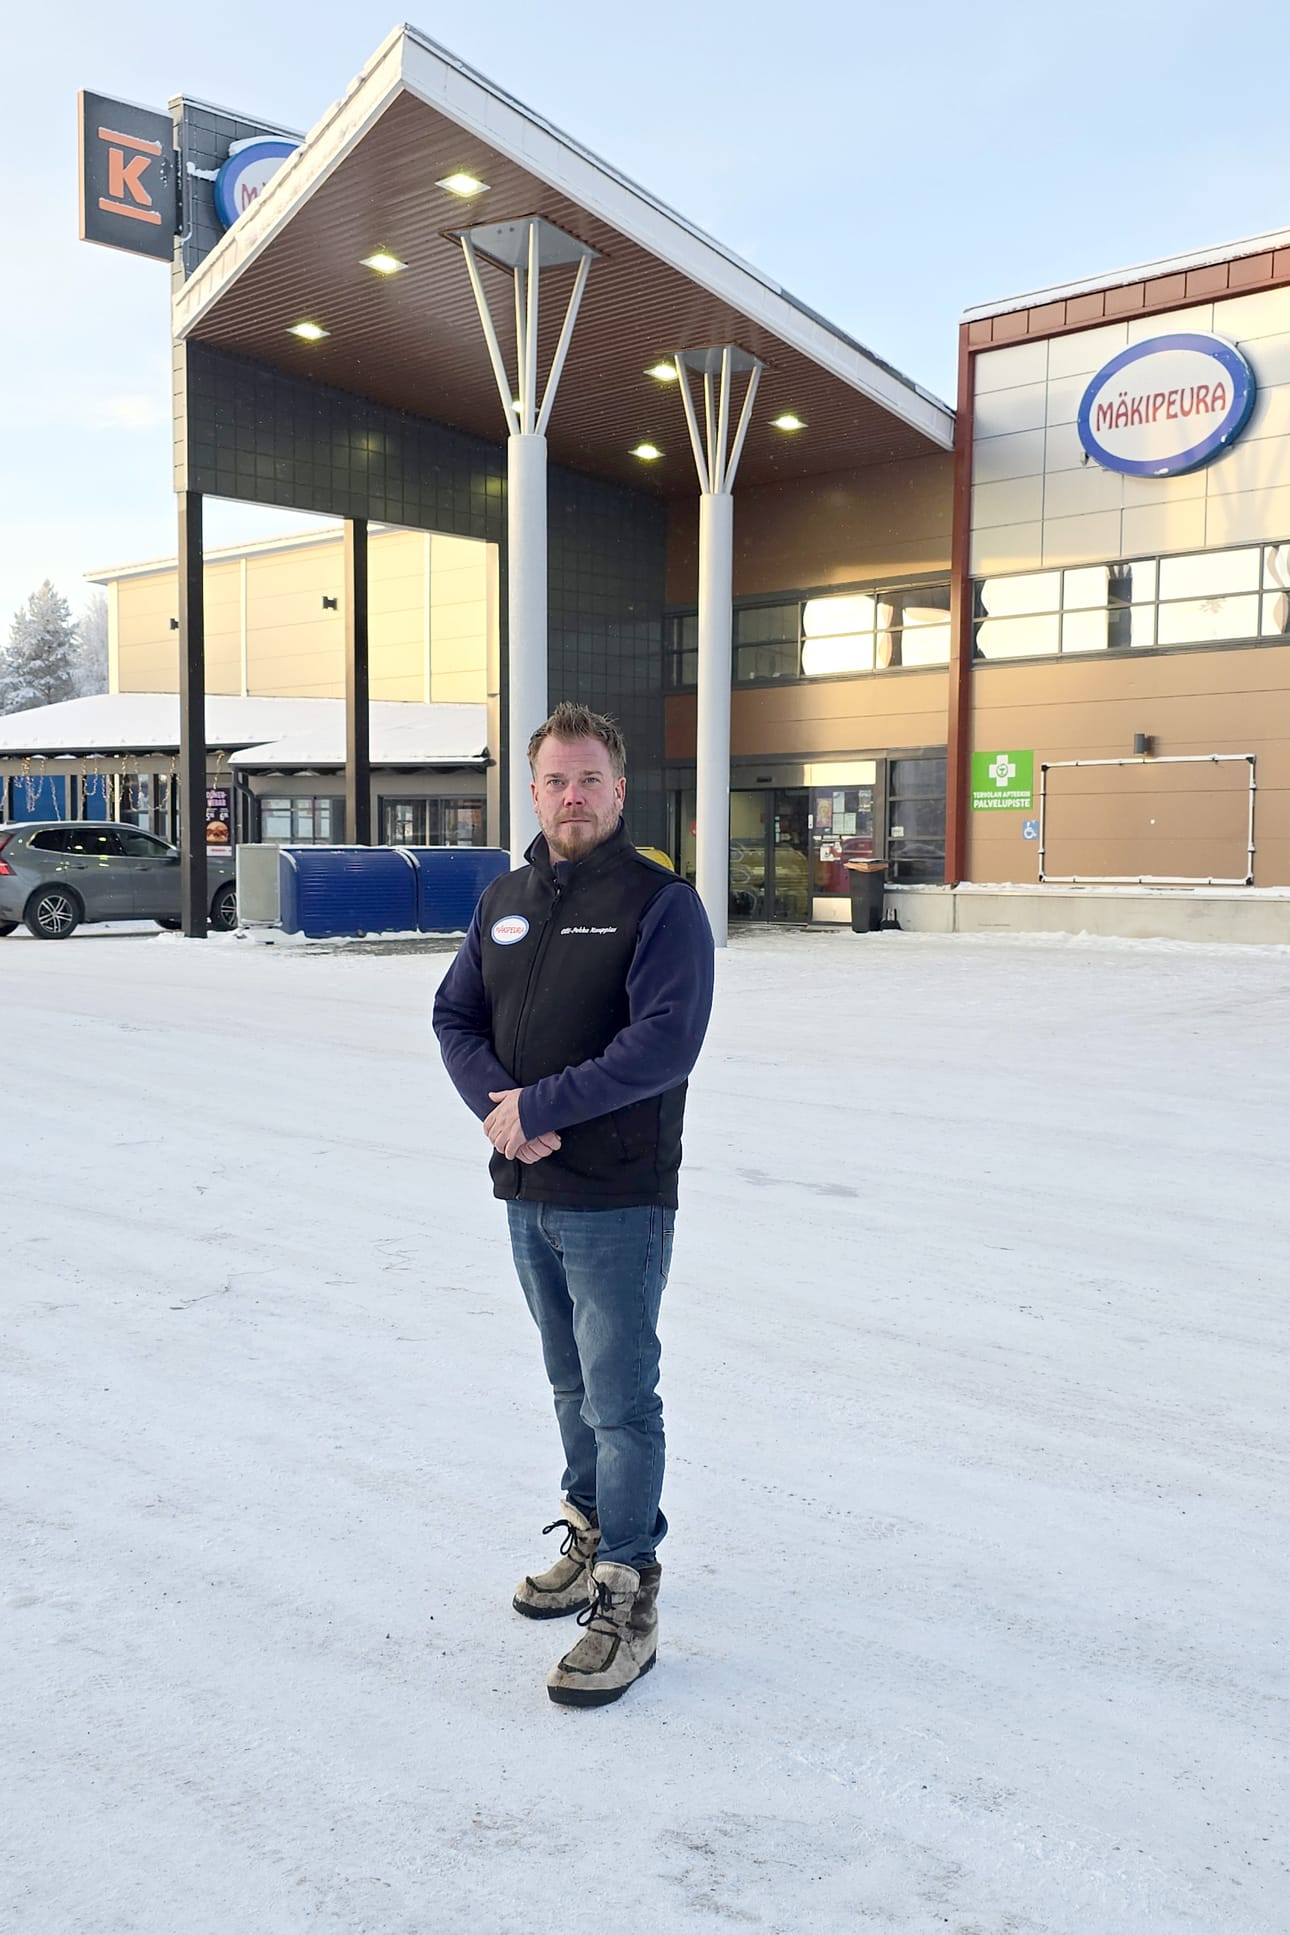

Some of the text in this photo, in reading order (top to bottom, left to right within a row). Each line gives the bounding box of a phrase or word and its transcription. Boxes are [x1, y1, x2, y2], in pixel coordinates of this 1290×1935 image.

[109, 147, 152, 206] K
[1096, 381, 1226, 432] MÄKIPEURA
[973, 798, 1030, 808] PALVELUPISTE
